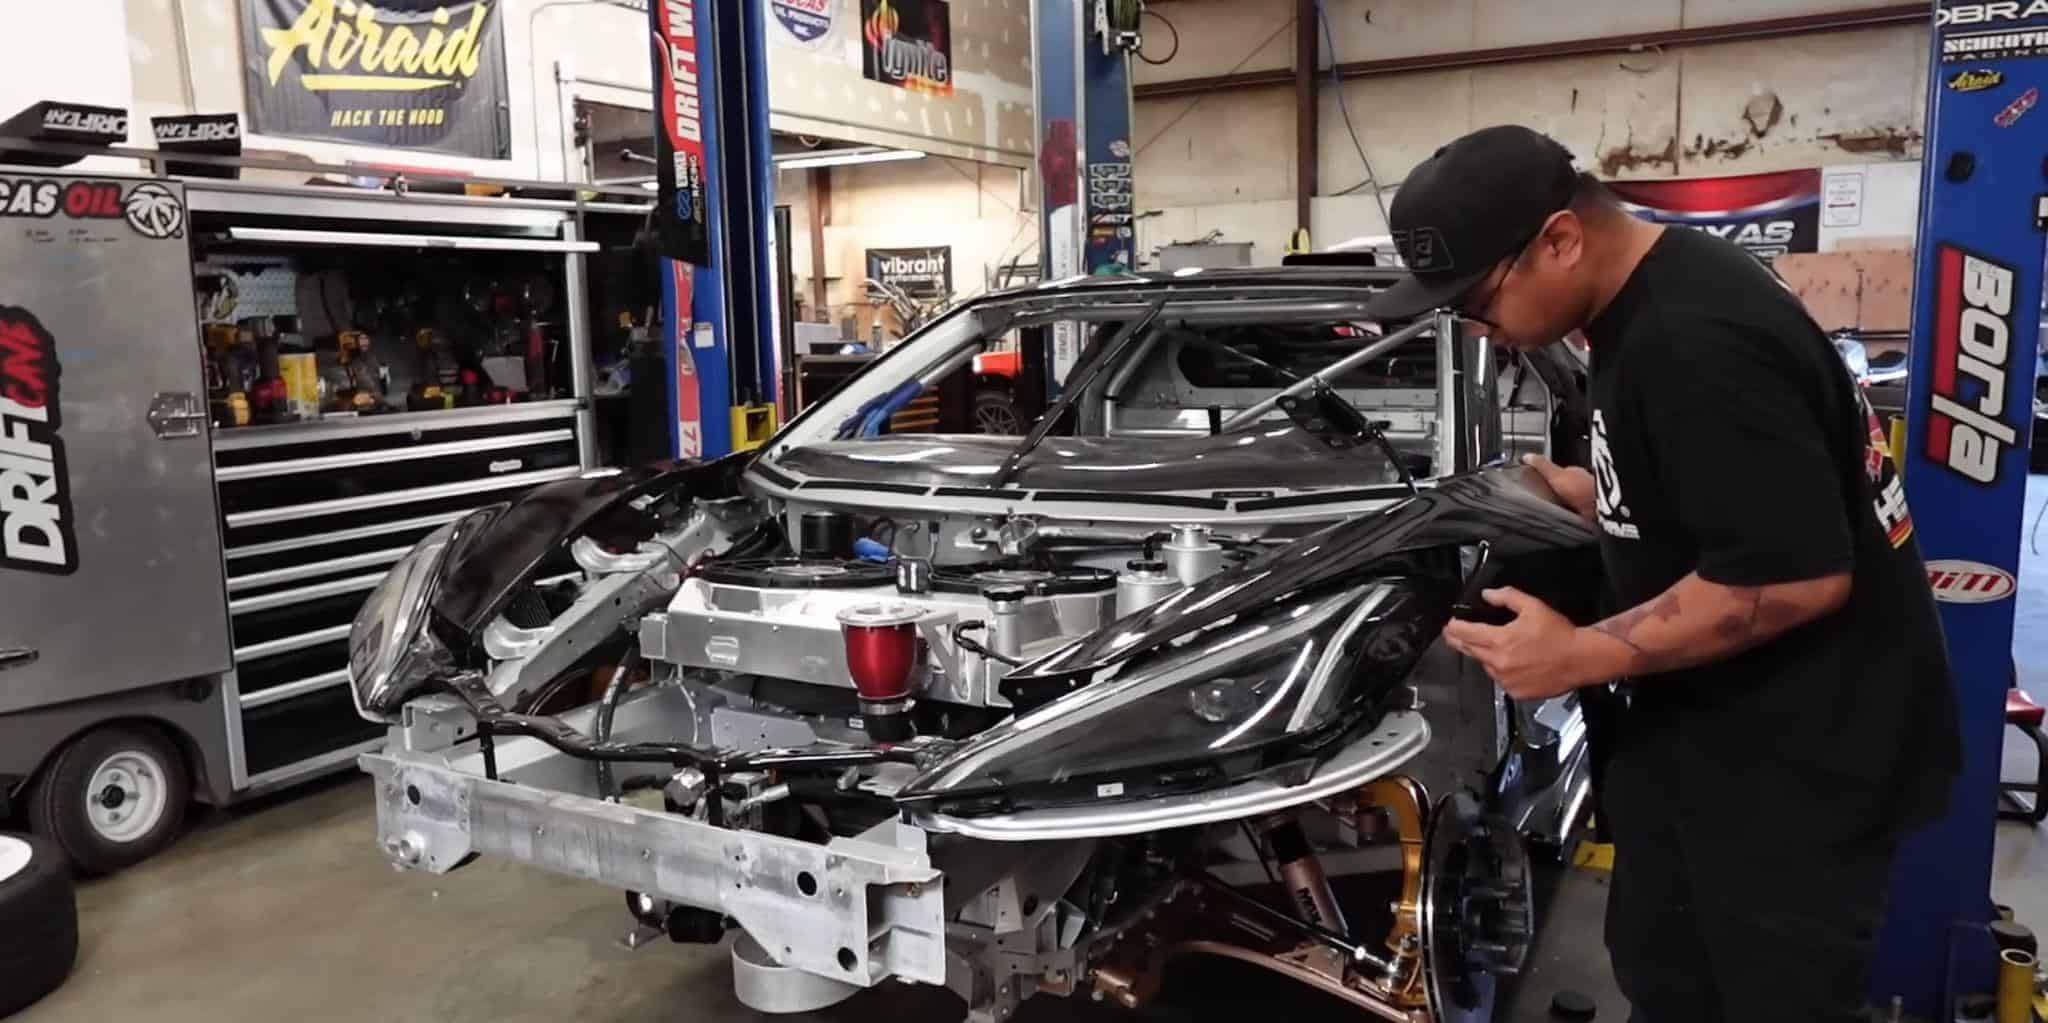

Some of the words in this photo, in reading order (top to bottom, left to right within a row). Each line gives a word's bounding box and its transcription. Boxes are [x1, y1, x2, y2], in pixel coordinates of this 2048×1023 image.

[667, 0, 694, 37] W
[261, 0, 487, 87] Airaid
[672, 43, 700, 142] DRIFT
[331, 110, 373, 128] HACK
[379, 109, 404, 126] THE
[409, 108, 445, 127] HOOD
[65, 183, 121, 216] OIL
[880, 255, 945, 273] vibrant
